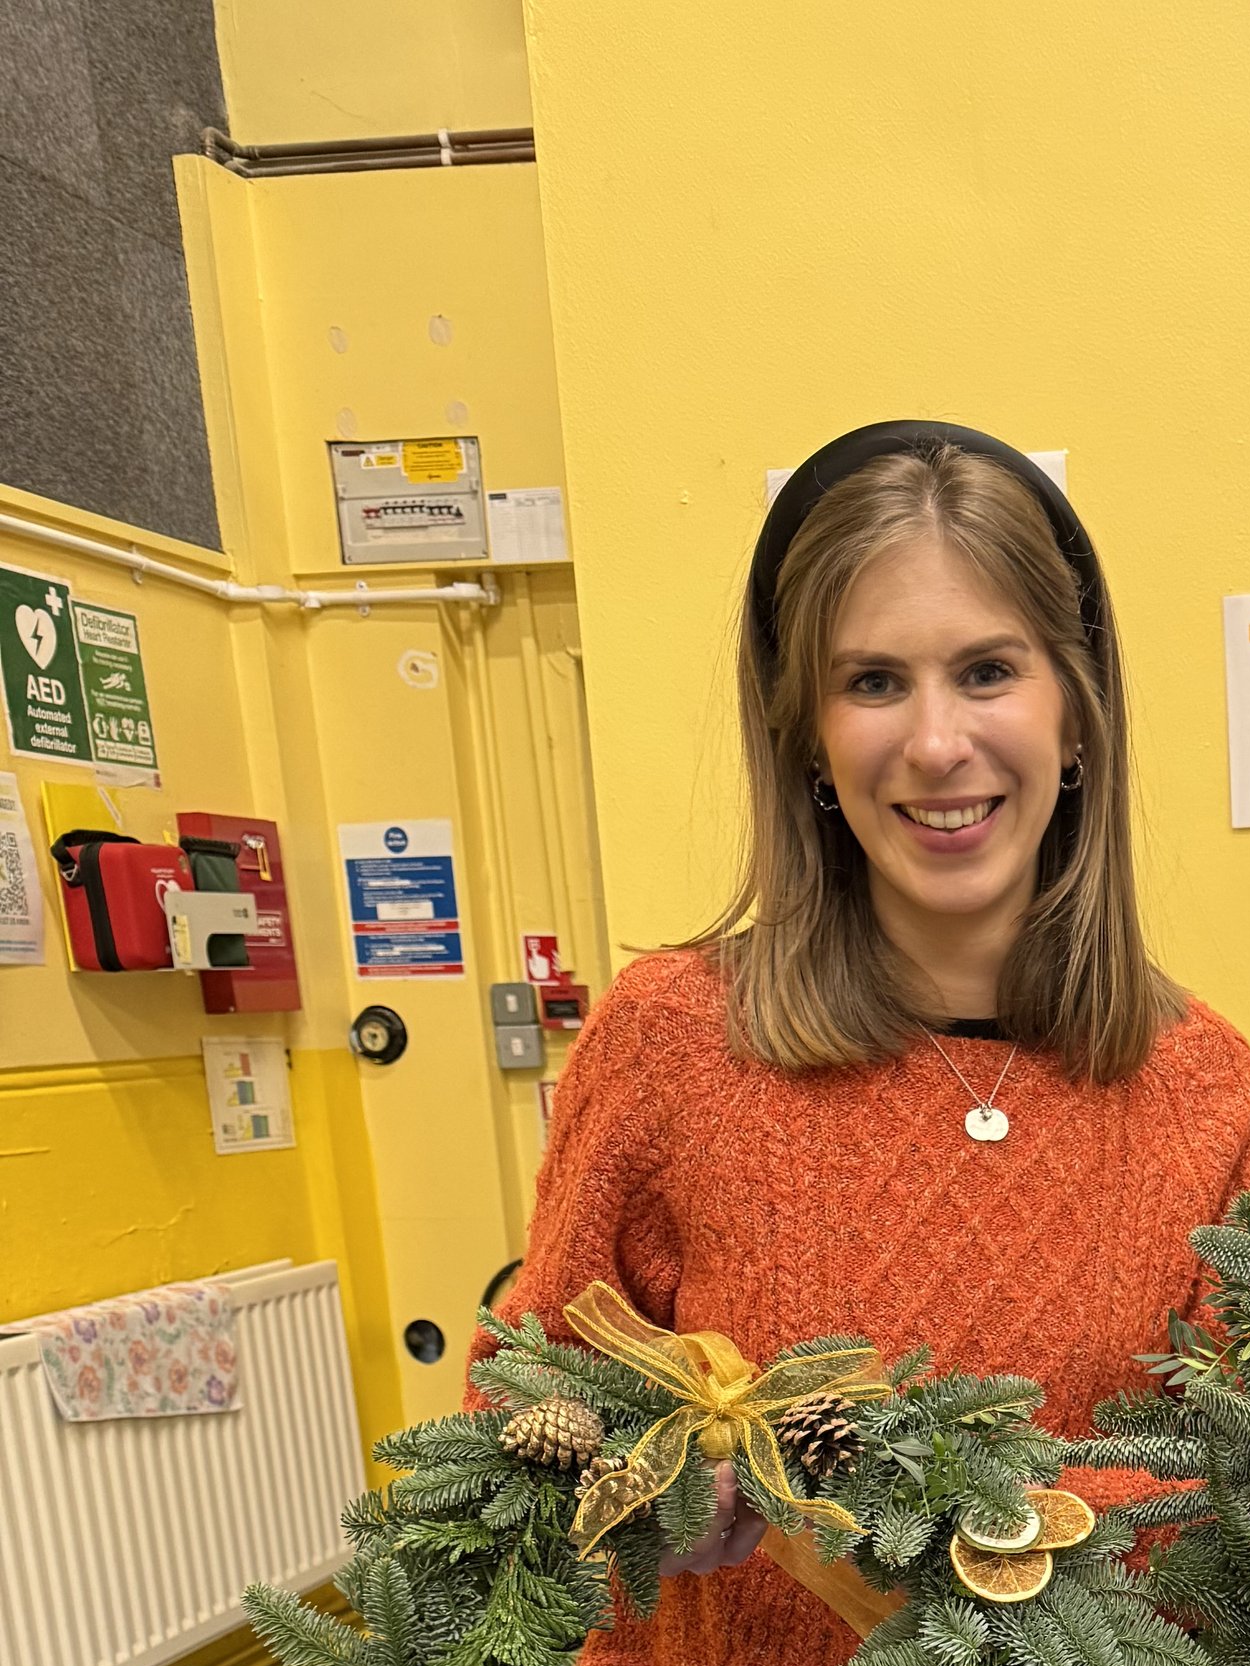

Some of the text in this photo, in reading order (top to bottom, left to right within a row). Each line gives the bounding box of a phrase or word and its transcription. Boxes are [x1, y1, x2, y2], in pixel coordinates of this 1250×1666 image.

[80, 612, 129, 636] Defibrillator
[27, 674, 66, 705] AED
[27, 705, 72, 724] Automated
[35, 722, 69, 738] external
[30, 735, 76, 753] defibrillator
